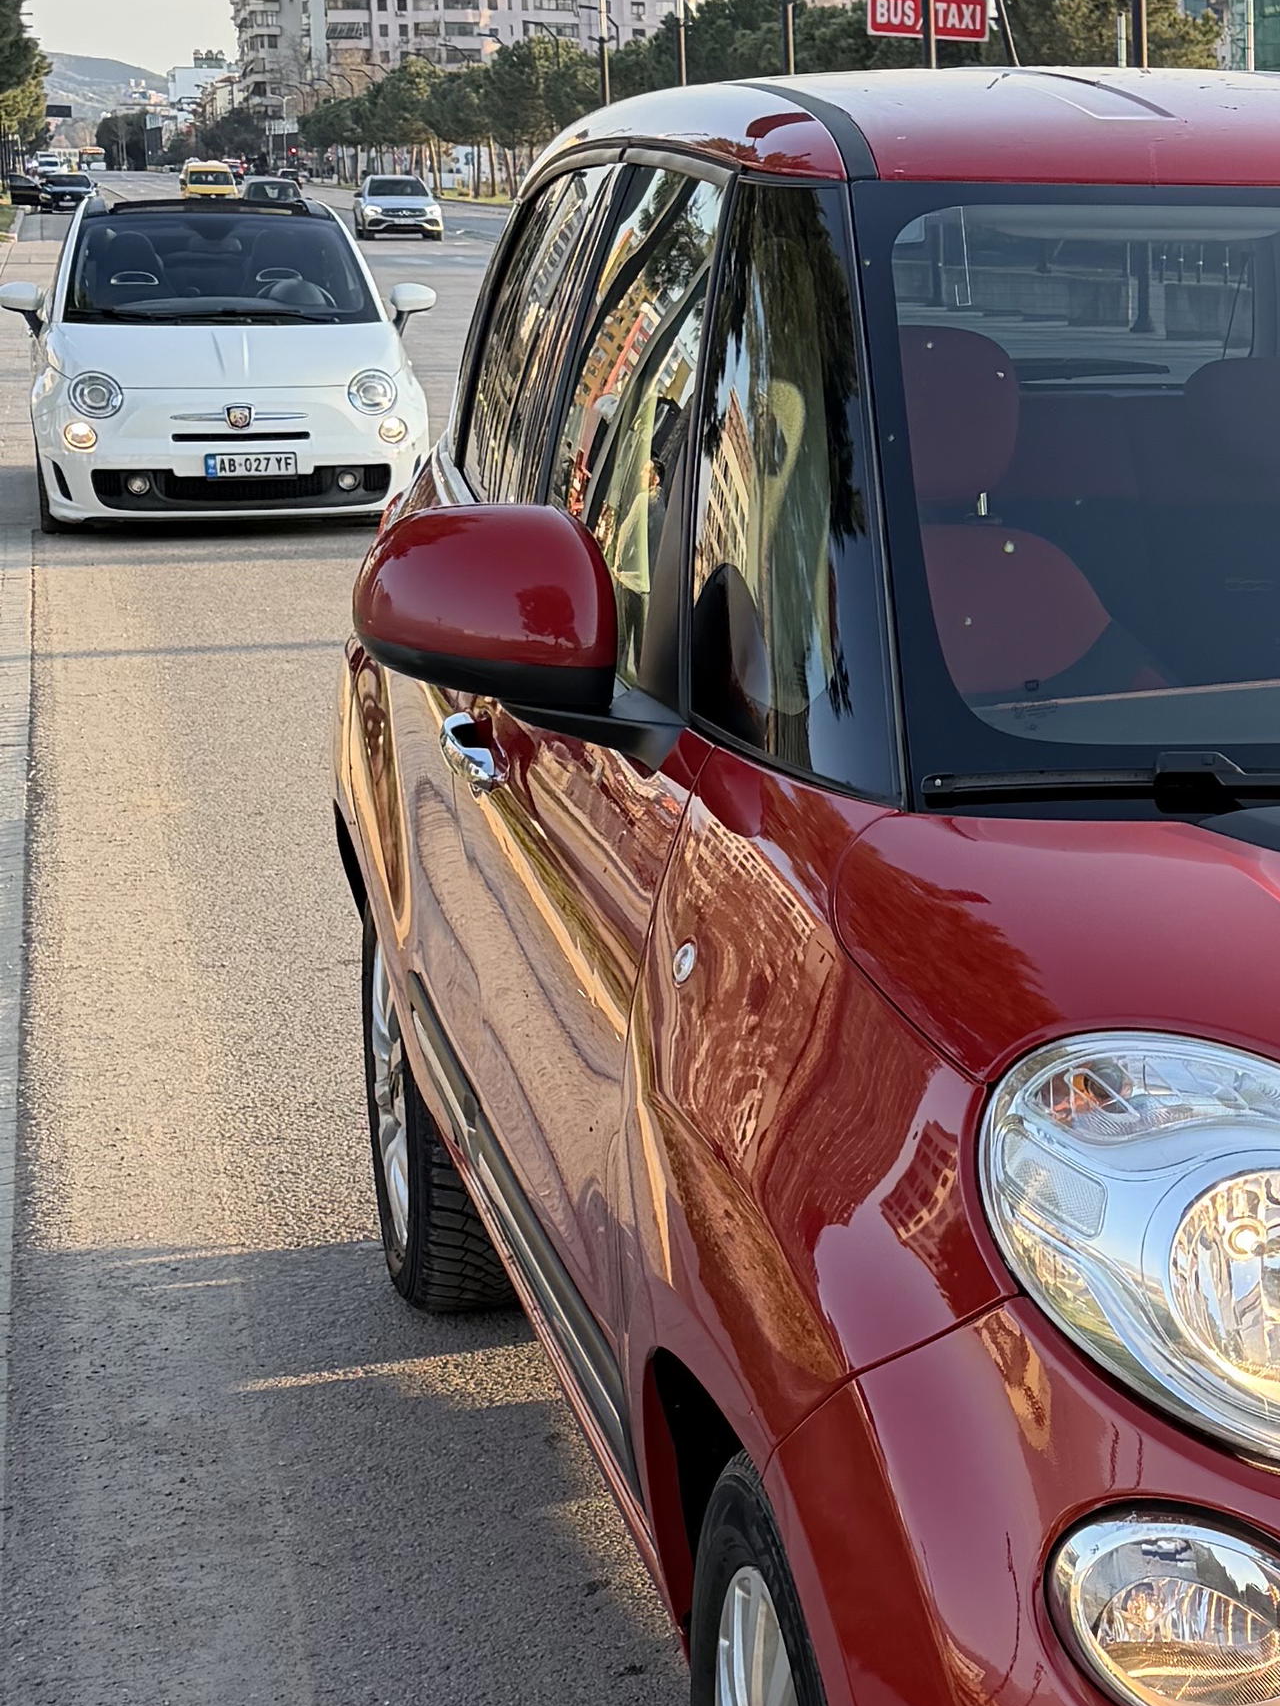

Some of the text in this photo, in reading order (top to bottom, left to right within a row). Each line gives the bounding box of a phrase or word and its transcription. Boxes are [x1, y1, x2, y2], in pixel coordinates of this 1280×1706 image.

[219, 457, 237, 473] AB
[244, 457, 271, 472] 027
[275, 456, 293, 471] YF
